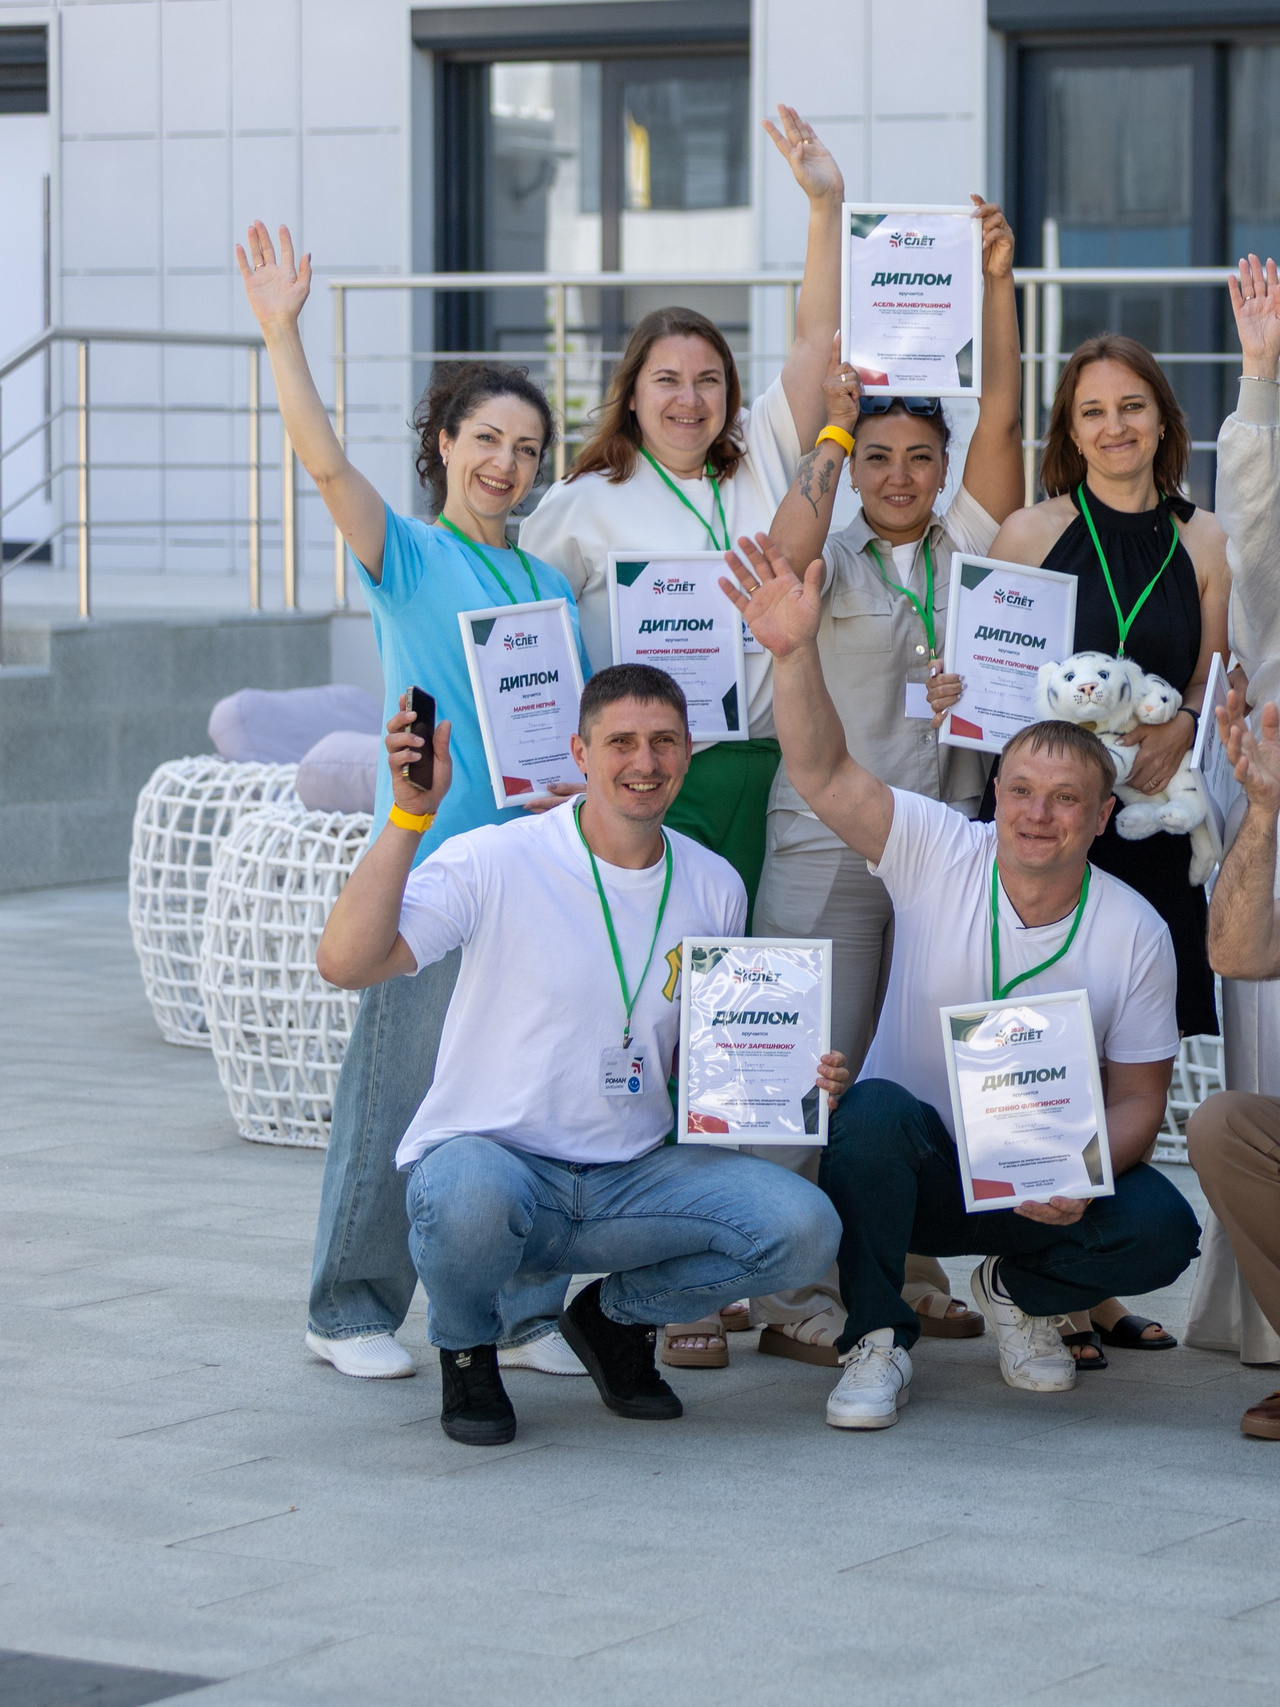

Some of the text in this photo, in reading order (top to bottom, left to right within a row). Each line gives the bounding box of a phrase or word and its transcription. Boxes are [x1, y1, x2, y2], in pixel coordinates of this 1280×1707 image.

[905, 235, 935, 246] СЛЁТ
[871, 272, 952, 286] ДИПЛОМ
[896, 301, 951, 309] ЖАНБУРШИНОЙ
[667, 582, 695, 592] СЛЁТ
[1006, 596, 1034, 608] СЛЁТ
[638, 619, 713, 634] ДИПЛОМ
[516, 634, 538, 647] СЛЁТ
[974, 625, 1046, 649] ДИПЛОМ
[973, 654, 1005, 664] СВЕТЛАНЕ
[499, 670, 559, 693] ДИПЛОМ
[513, 704, 535, 713] МАРИНЕ
[748, 971, 781, 982] СЛЁТ
[712, 1011, 799, 1026] ДИПЛОМ
[1010, 1029, 1043, 1042] СЛЁТ
[982, 1066, 1066, 1091] ДИПЛОМ
[985, 1104, 1020, 1114] ЕВГЕНИЮ
[1021, 1098, 1070, 1109] ФЛИГИНСКИХ
